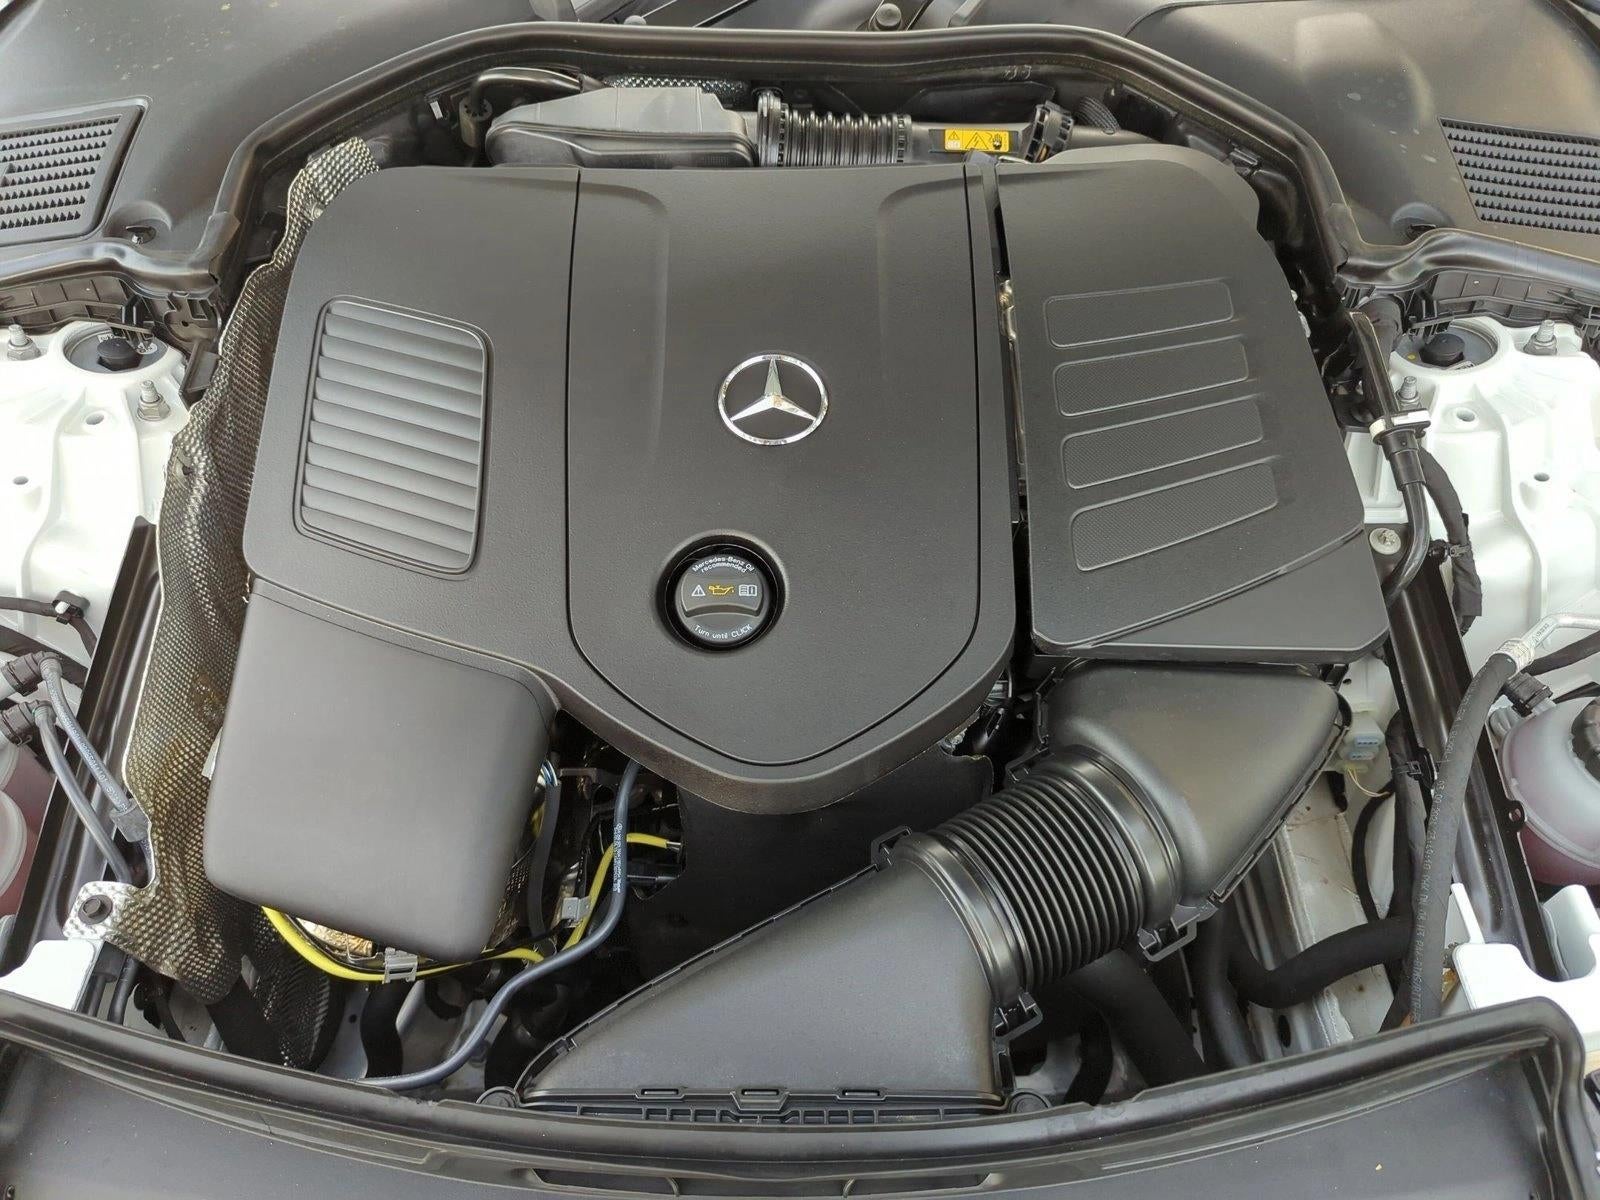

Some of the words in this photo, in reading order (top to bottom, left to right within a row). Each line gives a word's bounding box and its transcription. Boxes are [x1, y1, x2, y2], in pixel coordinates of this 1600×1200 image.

[701, 562, 747, 573] recommended
[745, 563, 755, 572] Oil
[694, 624, 710, 637] Turn
[731, 623, 753, 638] CLICK
